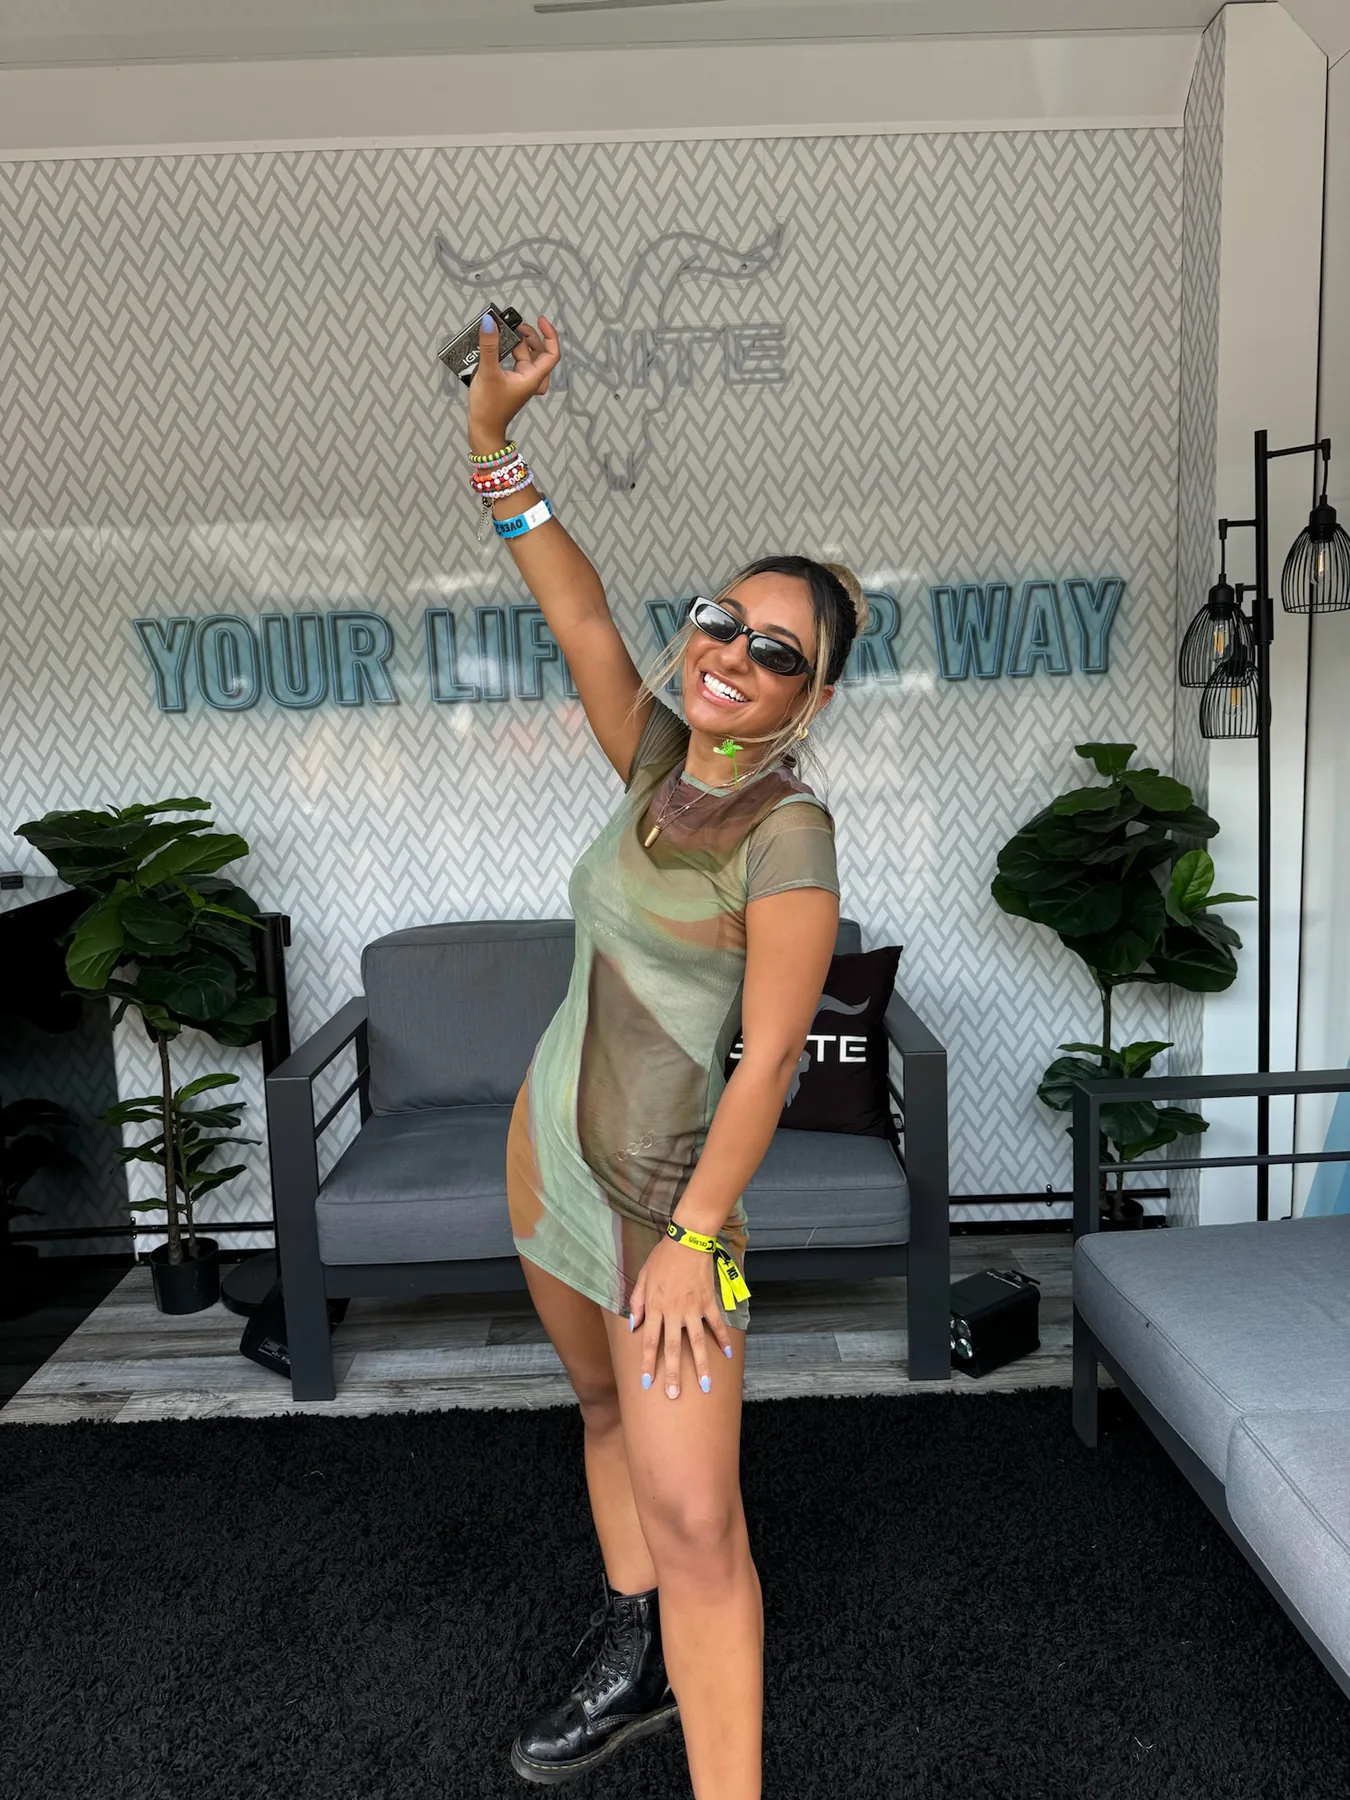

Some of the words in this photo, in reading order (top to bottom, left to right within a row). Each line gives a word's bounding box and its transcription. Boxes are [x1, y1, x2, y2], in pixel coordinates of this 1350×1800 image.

[132, 611, 400, 711] YOUR
[425, 605, 581, 703] LIF
[637, 591, 900, 693] YR
[930, 578, 1125, 680] WAY
